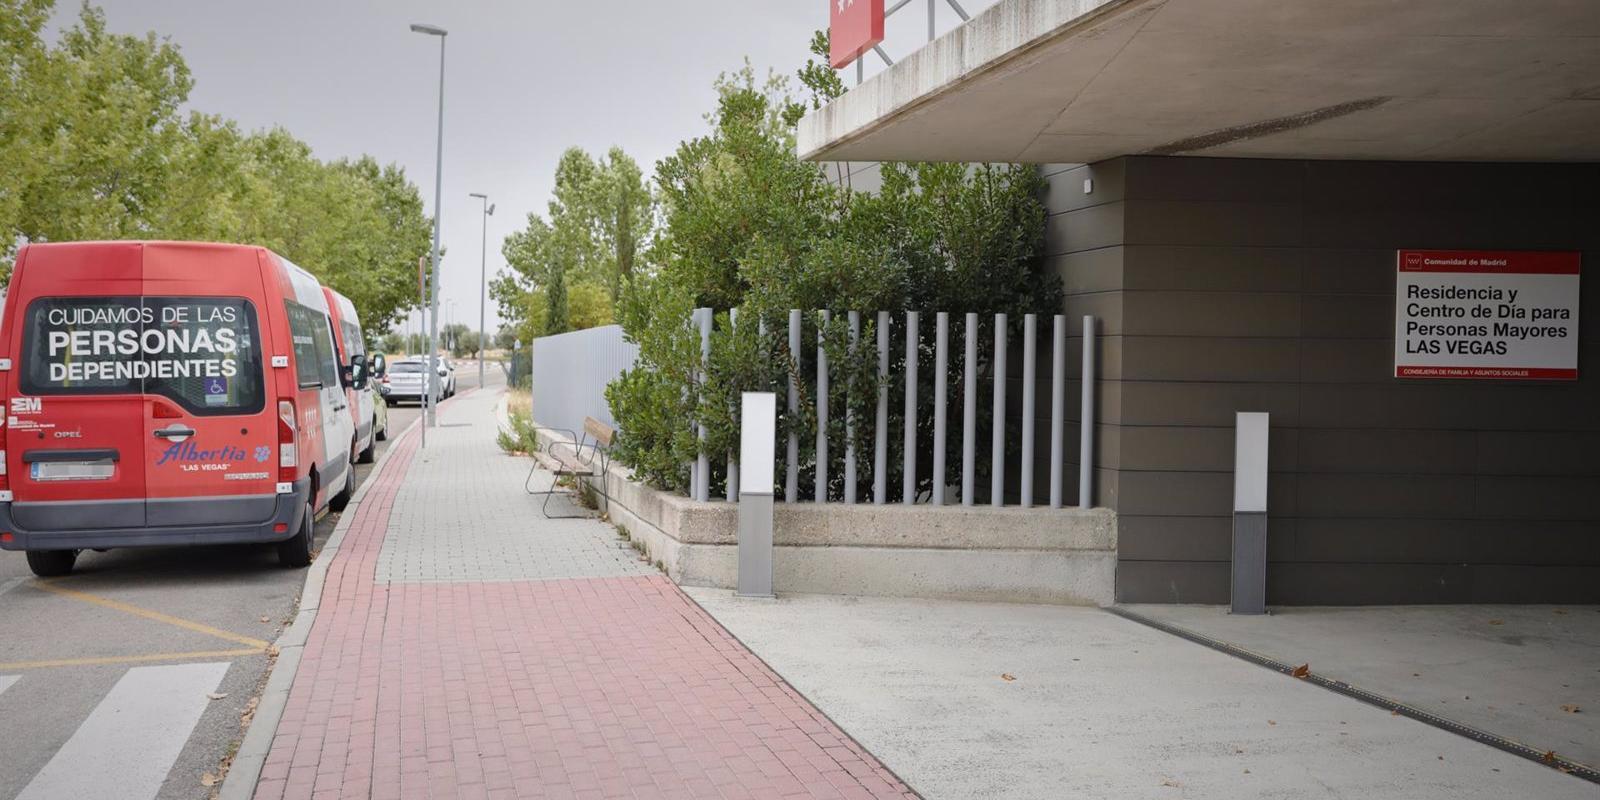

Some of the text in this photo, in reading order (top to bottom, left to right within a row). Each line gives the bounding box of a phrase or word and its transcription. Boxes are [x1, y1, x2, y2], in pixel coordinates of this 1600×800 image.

[1424, 258, 1467, 266] Comunidad
[1480, 259, 1507, 267] Madrid
[1407, 284, 1518, 303] Residencia y
[49, 306, 236, 325] CUIDAMOS DE LAS
[1406, 302, 1571, 322] Centro de Día para
[1406, 321, 1568, 340] Personas Mayores
[50, 329, 237, 356] PERSONAS
[1406, 339, 1508, 355] LAS VEGAS
[50, 359, 237, 382] DEPENDIENTES
[156, 441, 246, 465] Albertia
